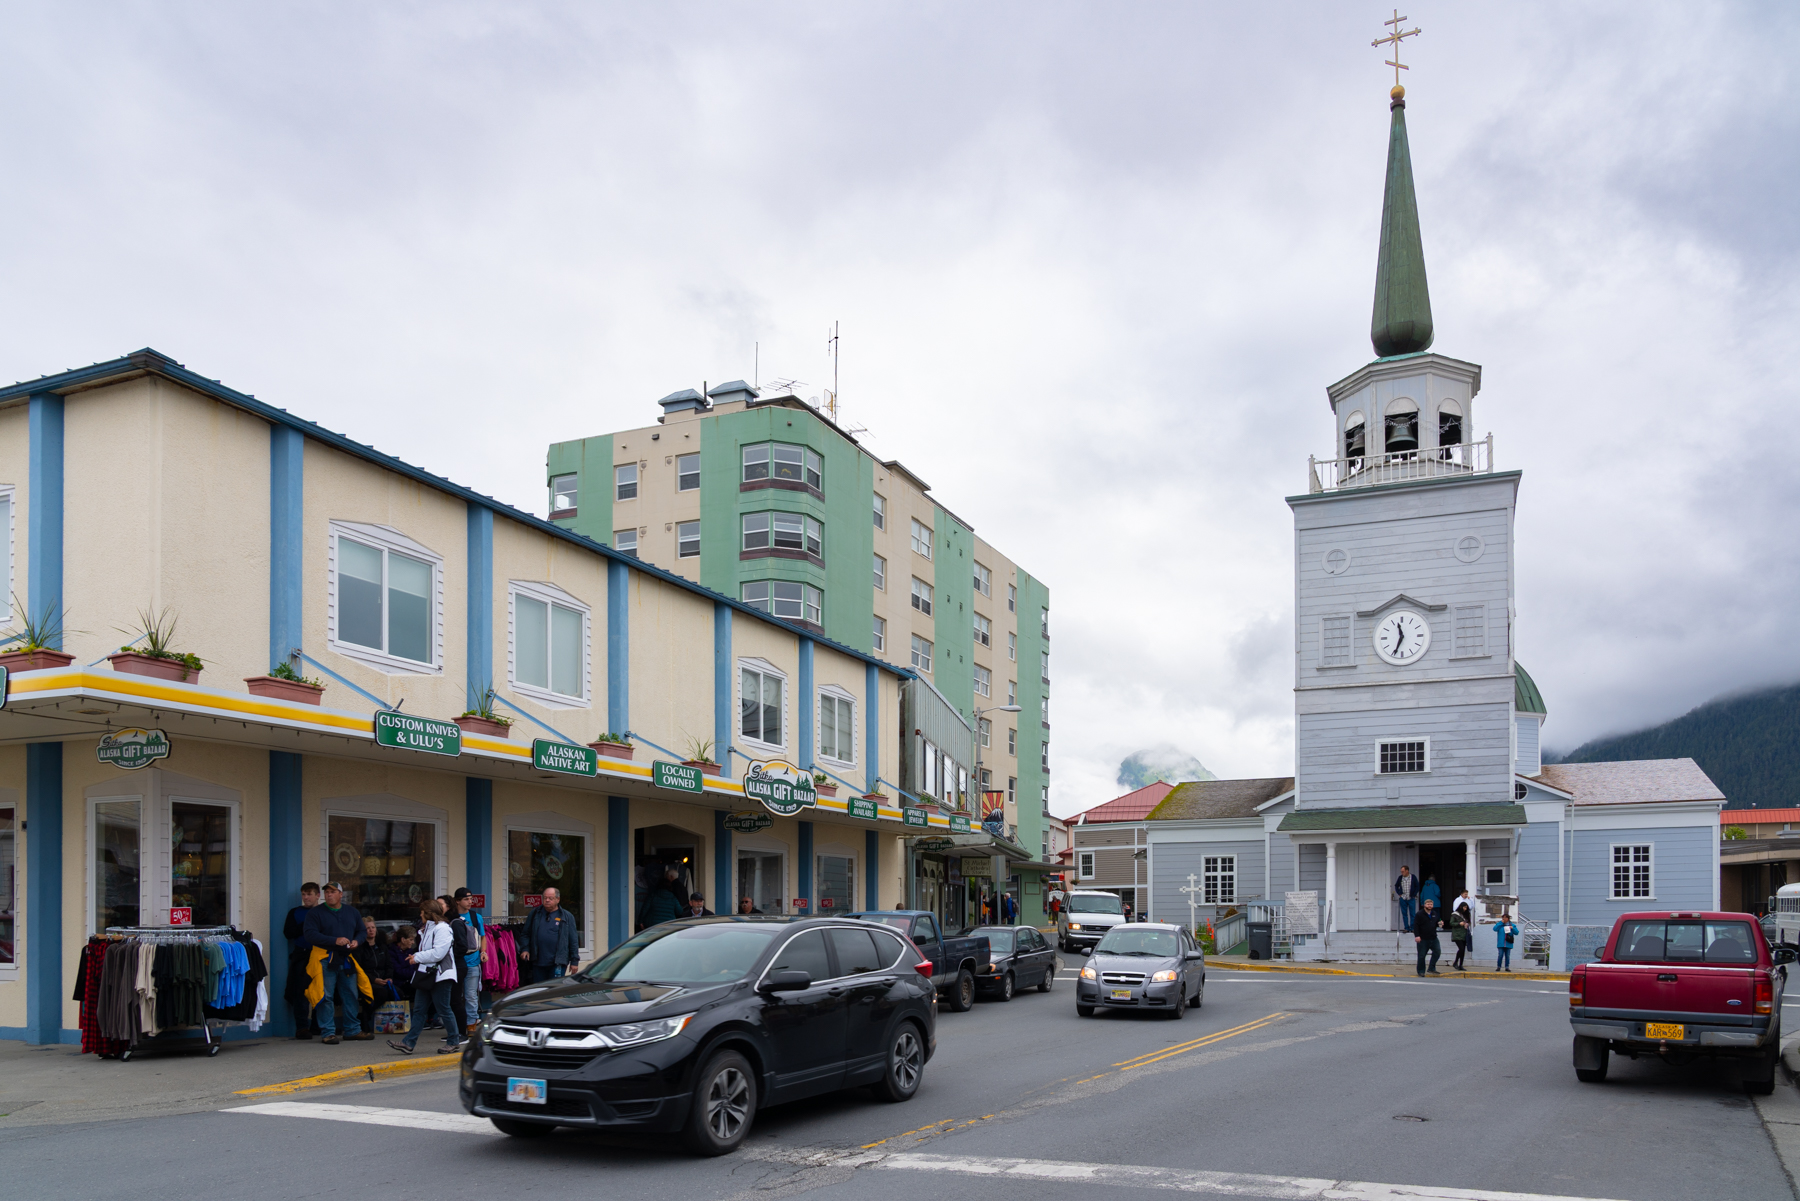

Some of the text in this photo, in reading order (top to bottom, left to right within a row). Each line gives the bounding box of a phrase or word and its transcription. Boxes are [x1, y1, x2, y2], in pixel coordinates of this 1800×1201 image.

[380, 714, 458, 738] CUSTOM KNIVES
[396, 732, 444, 750] & ULU'S
[100, 745, 166, 758] ALASKA GIFT BAZAAR
[548, 745, 586, 760] ALASKAN
[541, 755, 590, 772] NATIVE ART
[662, 764, 696, 778] LOCALLY
[750, 764, 774, 782] Sitka
[663, 775, 695, 789] OWNED
[748, 781, 814, 802] ALASKA GIFT BAZAAR
[768, 800, 784, 811] SINCE
[854, 800, 874, 810] SHIPPING
[853, 808, 874, 818] AVAILABLE
[908, 816, 924, 824] JEWELRY
